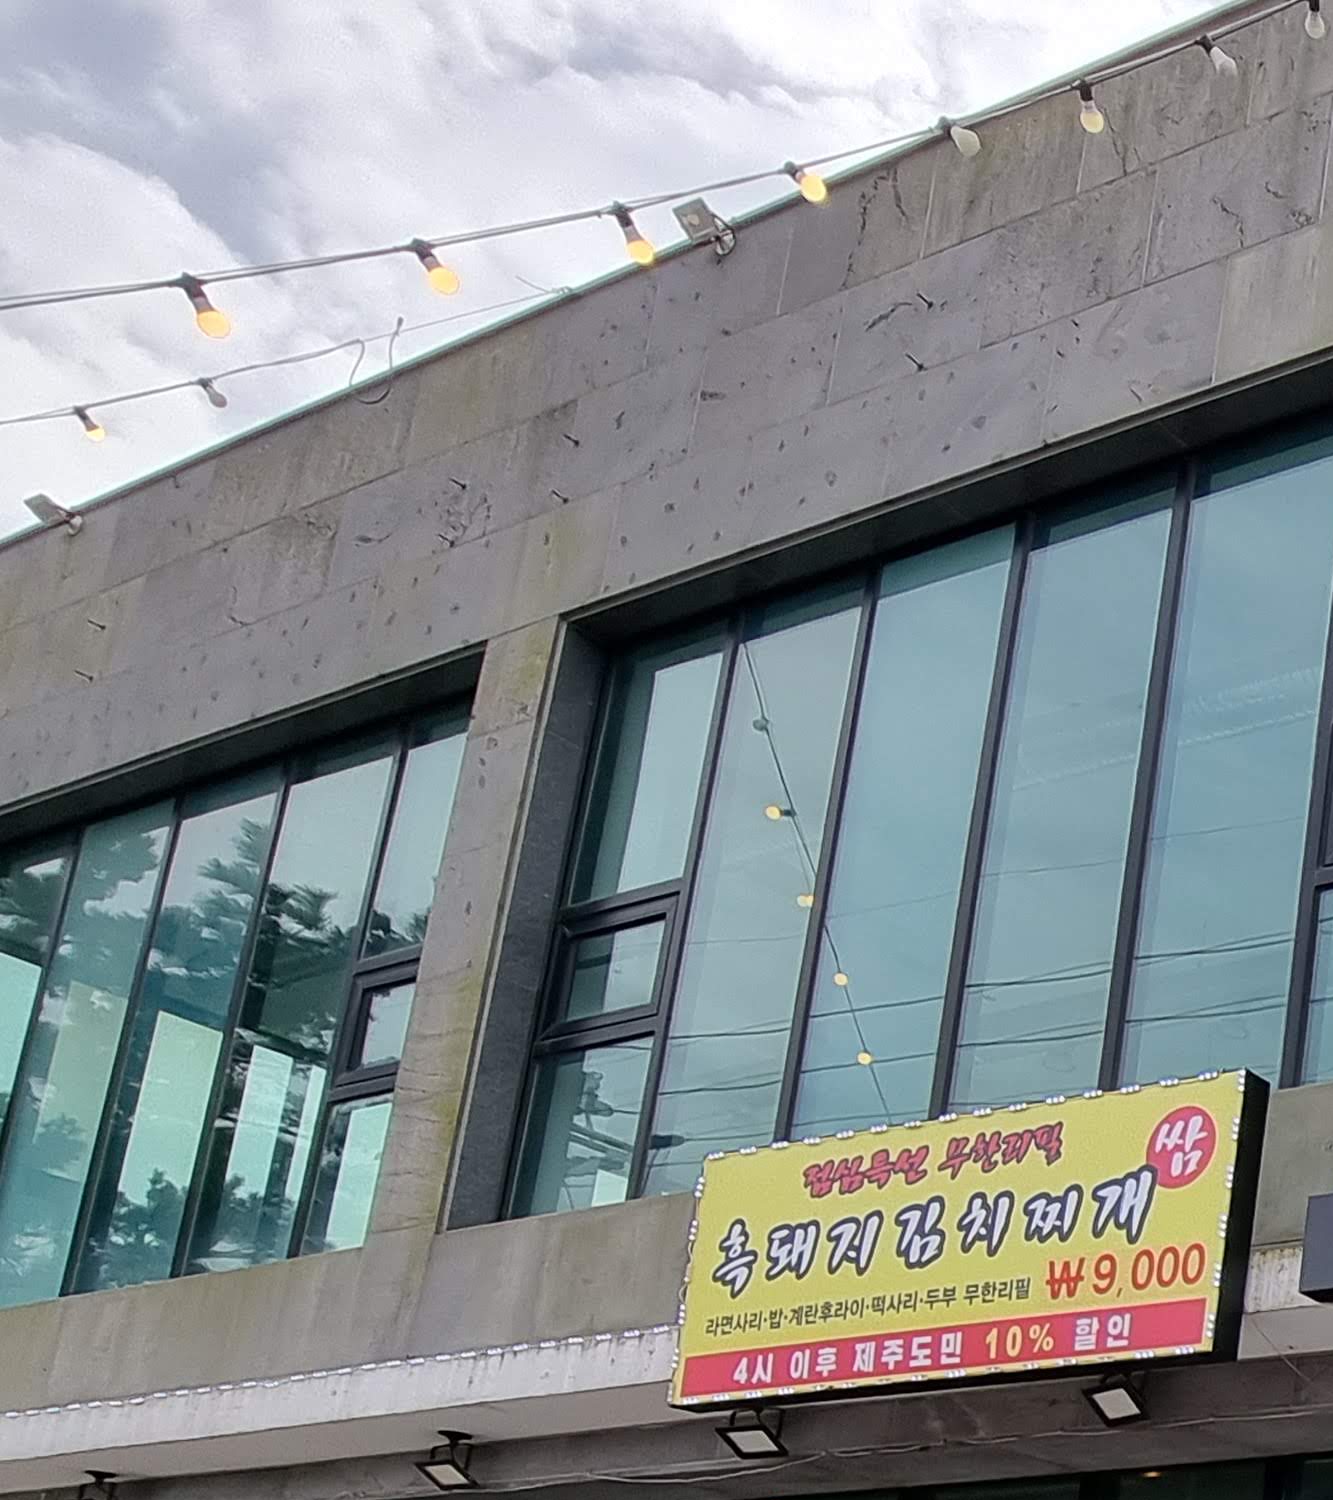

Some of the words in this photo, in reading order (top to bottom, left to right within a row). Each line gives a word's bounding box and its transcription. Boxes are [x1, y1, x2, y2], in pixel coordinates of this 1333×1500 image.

[802, 1146, 929, 1200] 점심특선
[937, 1122, 1065, 1173] 무한리필
[1154, 1113, 1208, 1176] 쌈
[712, 1165, 1158, 1299] 흑돼지김치찌개
[963, 1277, 1032, 1306] 무한리필
[733, 1355, 774, 1386] 4시
[789, 1345, 837, 1379] 이후
[852, 1329, 964, 1373] 제주도민
[984, 1322, 1055, 1359] 10%
[1073, 1315, 1132, 1353] 할인
